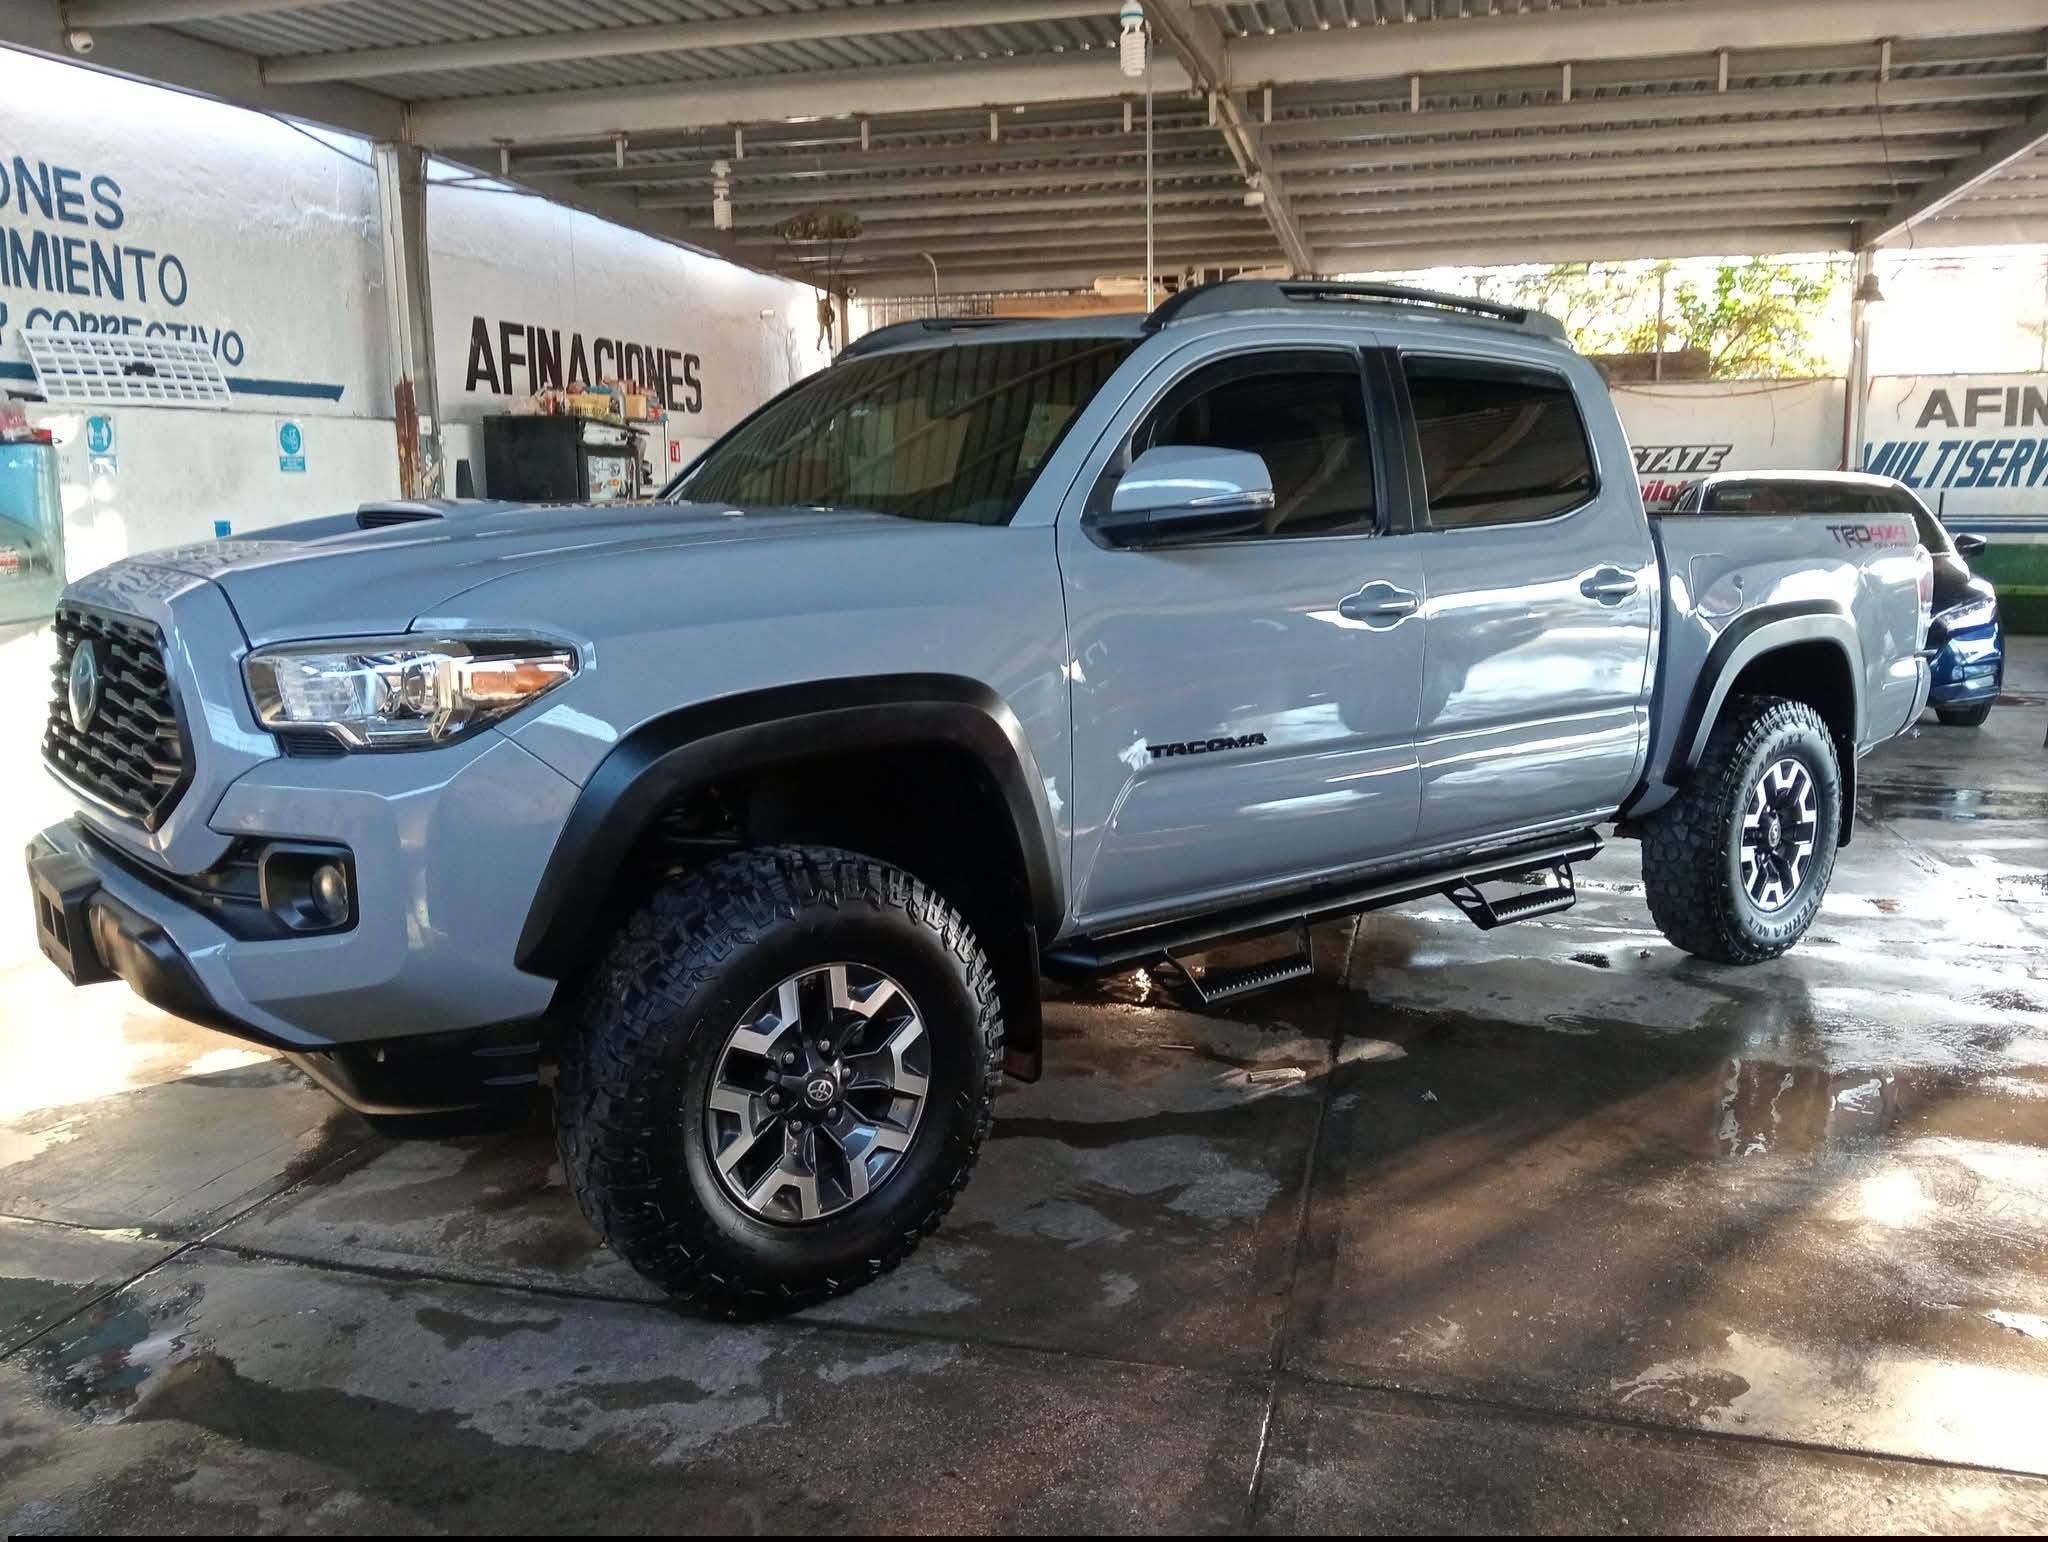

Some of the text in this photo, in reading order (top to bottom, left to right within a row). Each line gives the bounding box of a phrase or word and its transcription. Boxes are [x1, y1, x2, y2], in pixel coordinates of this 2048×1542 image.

[465, 316, 703, 414] AFINACIONES
[1914, 386, 2048, 429] AFIN
[1146, 732, 1268, 758] TACOMA
[1774, 896, 1817, 938] TERRA
